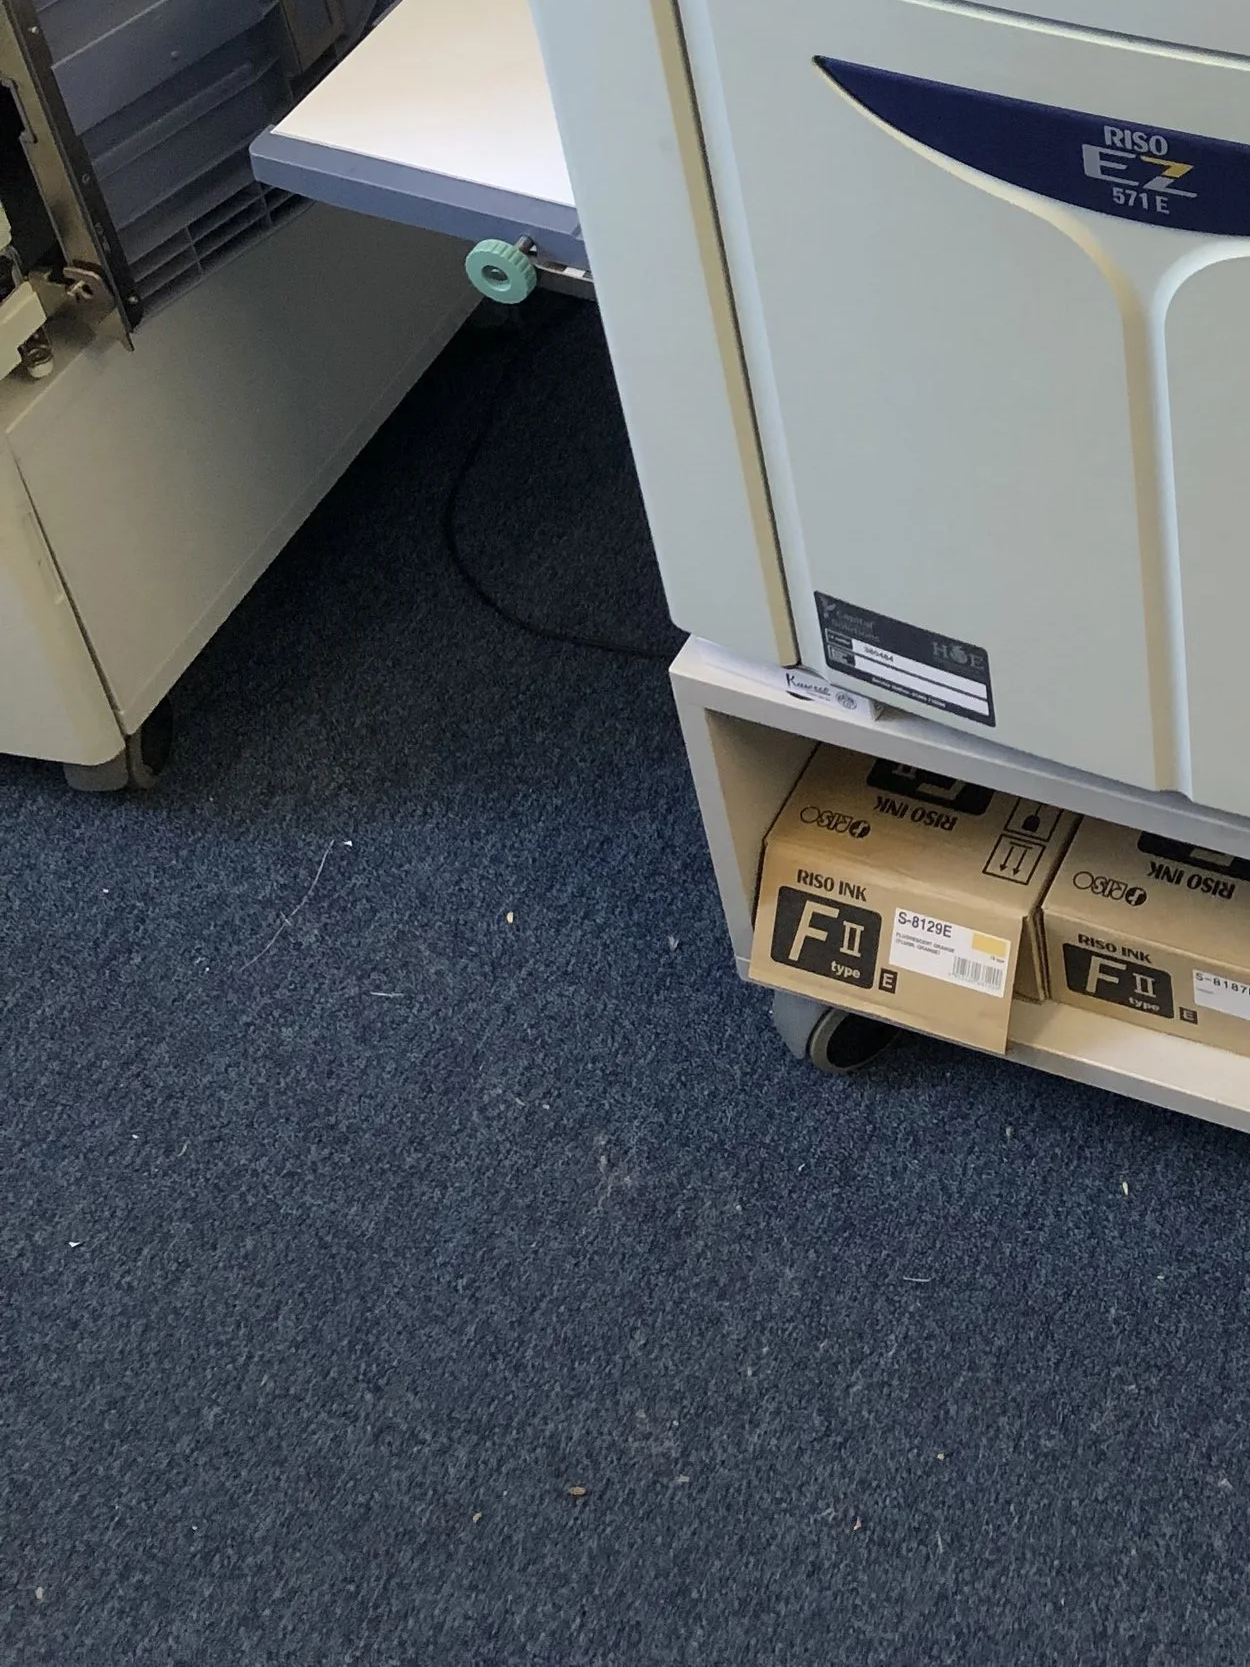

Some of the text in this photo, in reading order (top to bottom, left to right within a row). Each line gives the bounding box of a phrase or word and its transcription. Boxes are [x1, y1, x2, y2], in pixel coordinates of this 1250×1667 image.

[1103, 125, 1168, 156] RISO
[1082, 144, 1198, 198] EZ
[800, 805, 852, 826] RISO
[874, 795, 958, 831] RISO INK
[797, 869, 867, 902] RISO INK
[1073, 871, 1128, 900] RISO
[1147, 861, 1236, 900] RISO INK
[788, 900, 840, 962] F
[898, 911, 952, 938] S-8129E
[1078, 934, 1152, 964] RISO INK
[830, 960, 861, 979] type
[1086, 955, 1127, 993] F
[1128, 996, 1160, 1012] type
